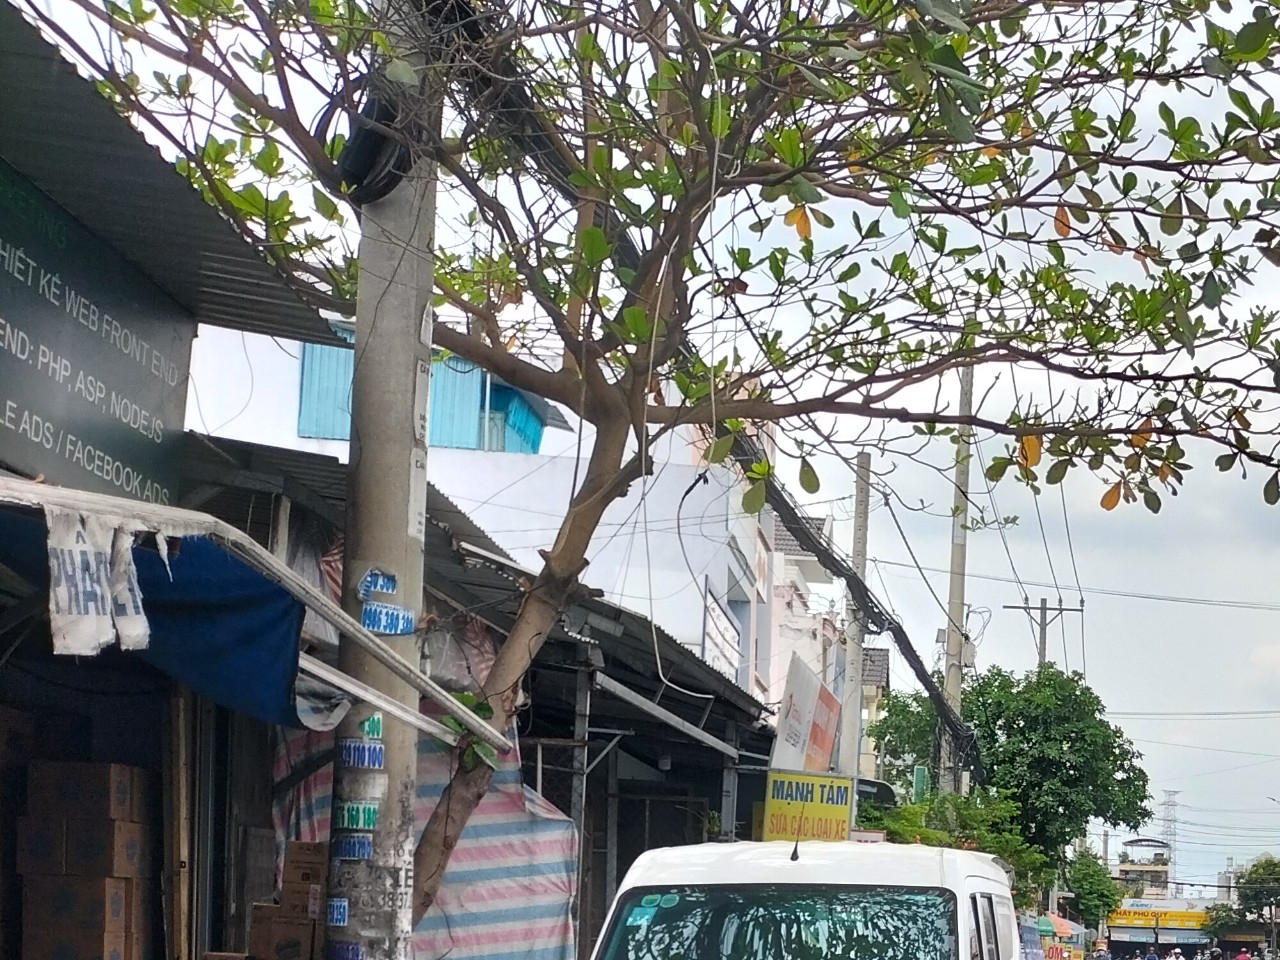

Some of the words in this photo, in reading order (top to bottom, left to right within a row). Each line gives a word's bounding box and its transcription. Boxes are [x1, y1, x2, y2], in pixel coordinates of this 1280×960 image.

[65, 286, 99, 331] WEB
[102, 314, 150, 366] FRONT
[151, 350, 178, 386] END
[110, 391, 164, 443] NODEJS
[0, 400, 18, 430] E
[19, 410, 54, 449] ADS
[65, 434, 143, 497] FACEBOOK
[143, 479, 169, 505] ADS
[772, 780, 814, 805] MẠNH
[819, 781, 849, 806] TÁM
[834, 819, 848, 841] XE
